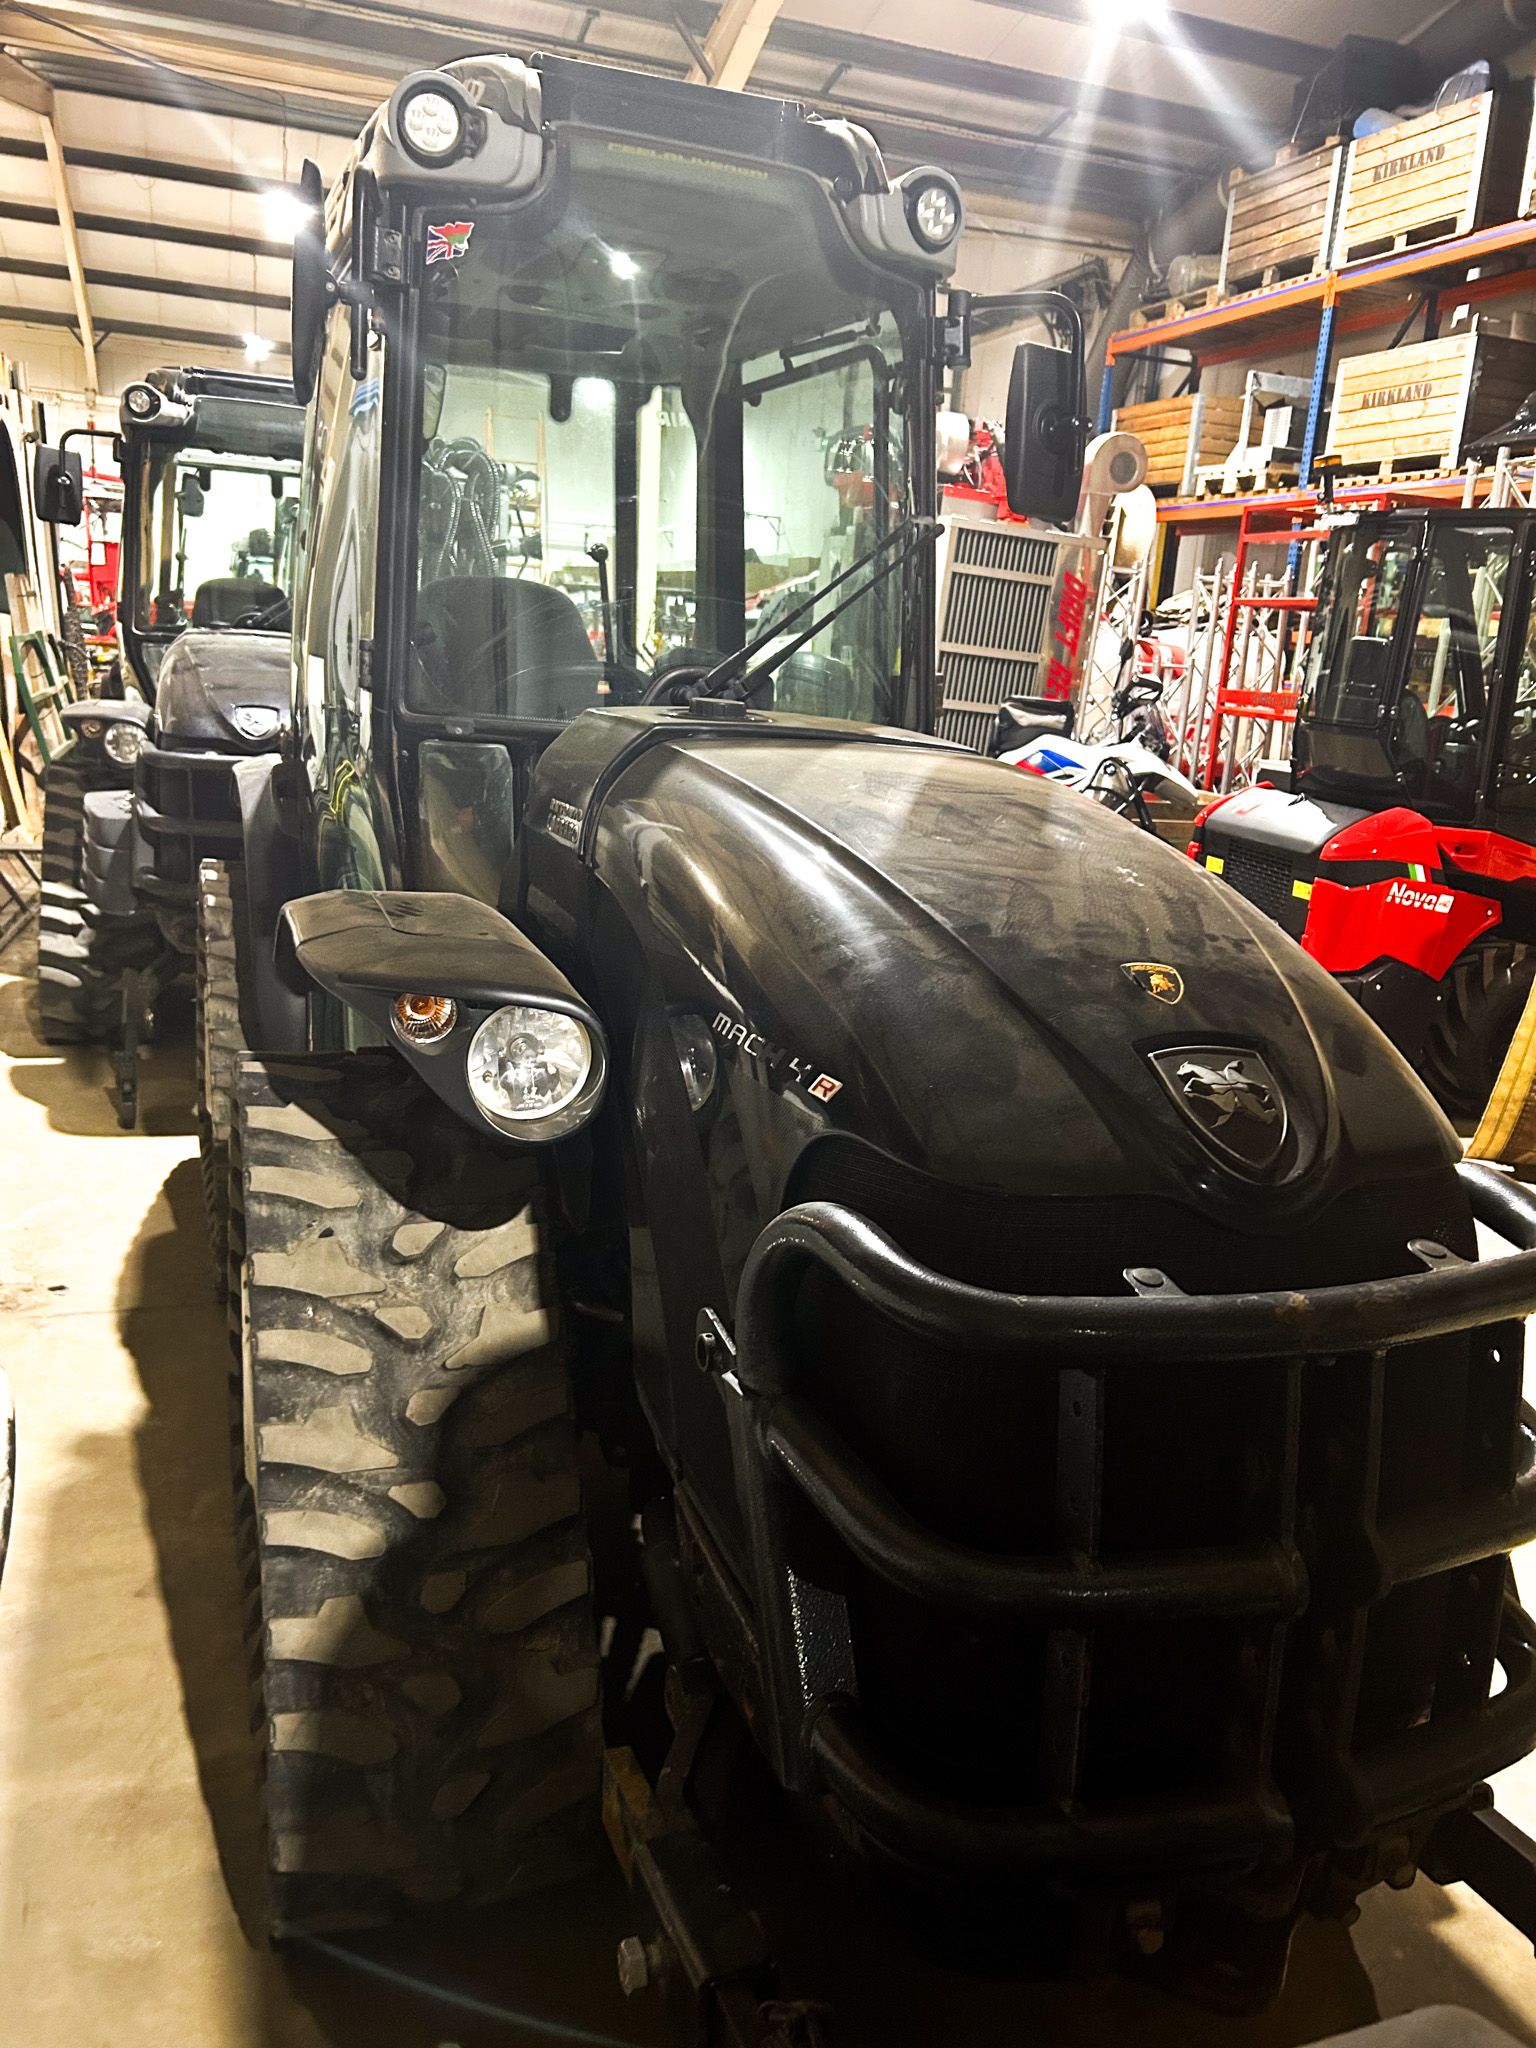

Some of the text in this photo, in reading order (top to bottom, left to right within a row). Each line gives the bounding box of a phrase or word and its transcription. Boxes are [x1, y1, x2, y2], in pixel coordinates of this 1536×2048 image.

[1373, 144, 1445, 182] KIRKLAND
[1362, 383, 1432, 409] KIRKLAND
[1055, 570, 1088, 657] DRIFT
[1386, 881, 1438, 911] Nova
[809, 1075, 840, 1101] R
